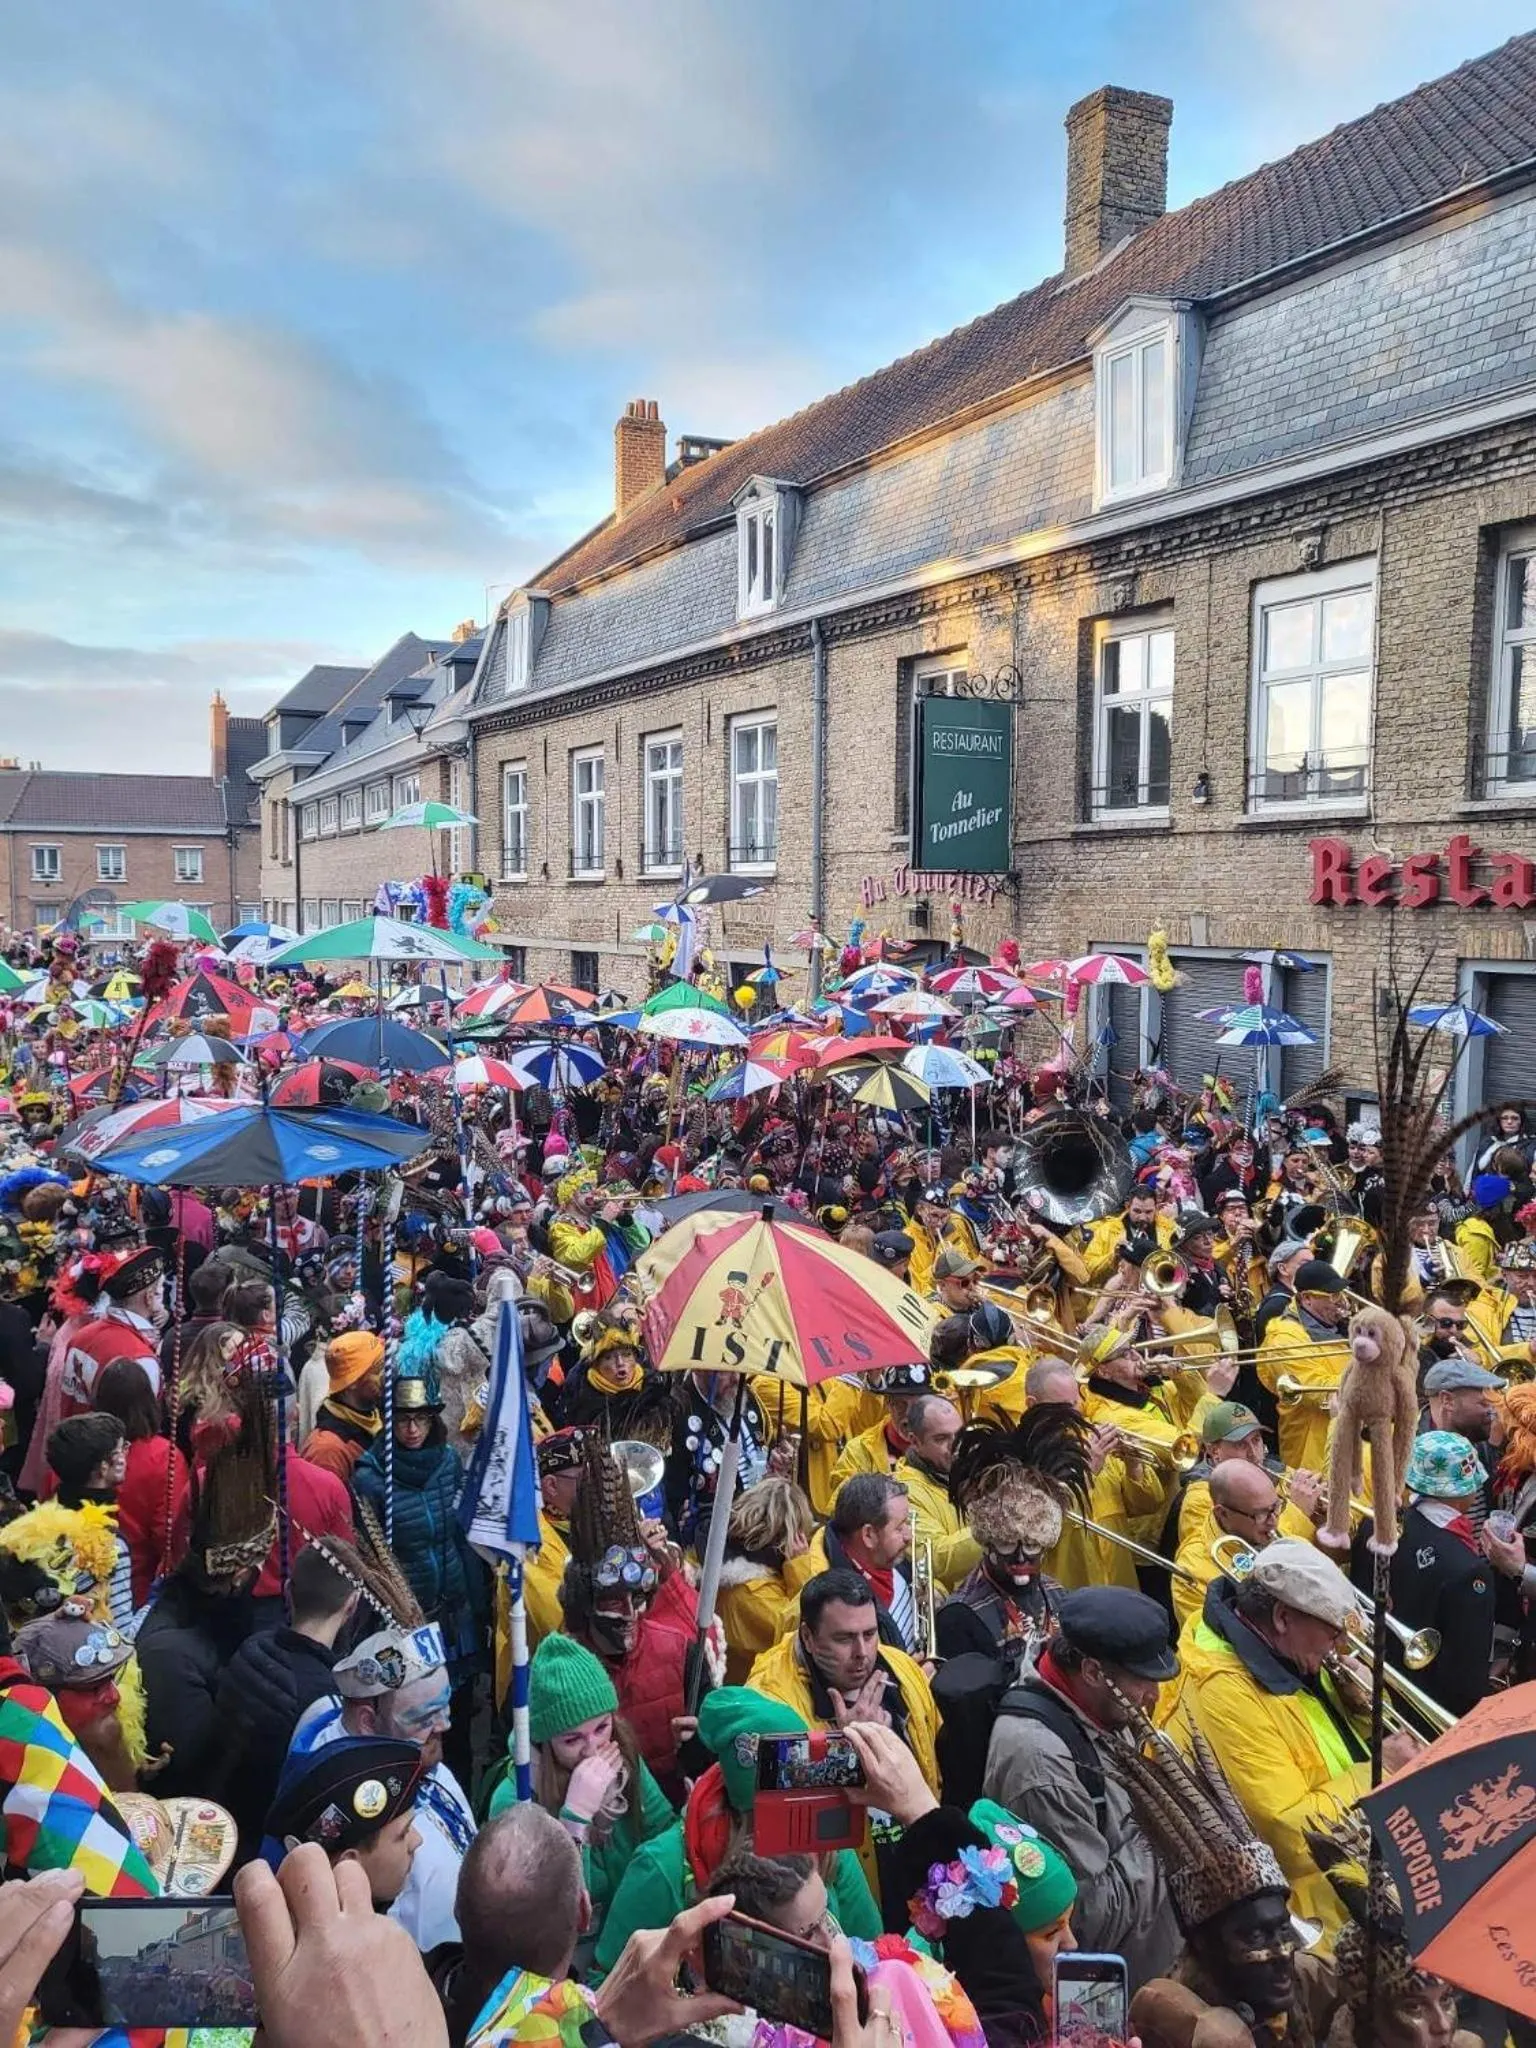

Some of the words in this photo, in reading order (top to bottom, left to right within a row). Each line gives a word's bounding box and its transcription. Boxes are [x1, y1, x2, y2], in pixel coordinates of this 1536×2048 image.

[932, 731, 1004, 753] RESTAURANT
[951, 789, 974, 813] Au
[930, 807, 1003, 844] Tonnelier
[1308, 834, 1536, 908] Resta
[1384, 1804, 1443, 1916] REXPOEDE
